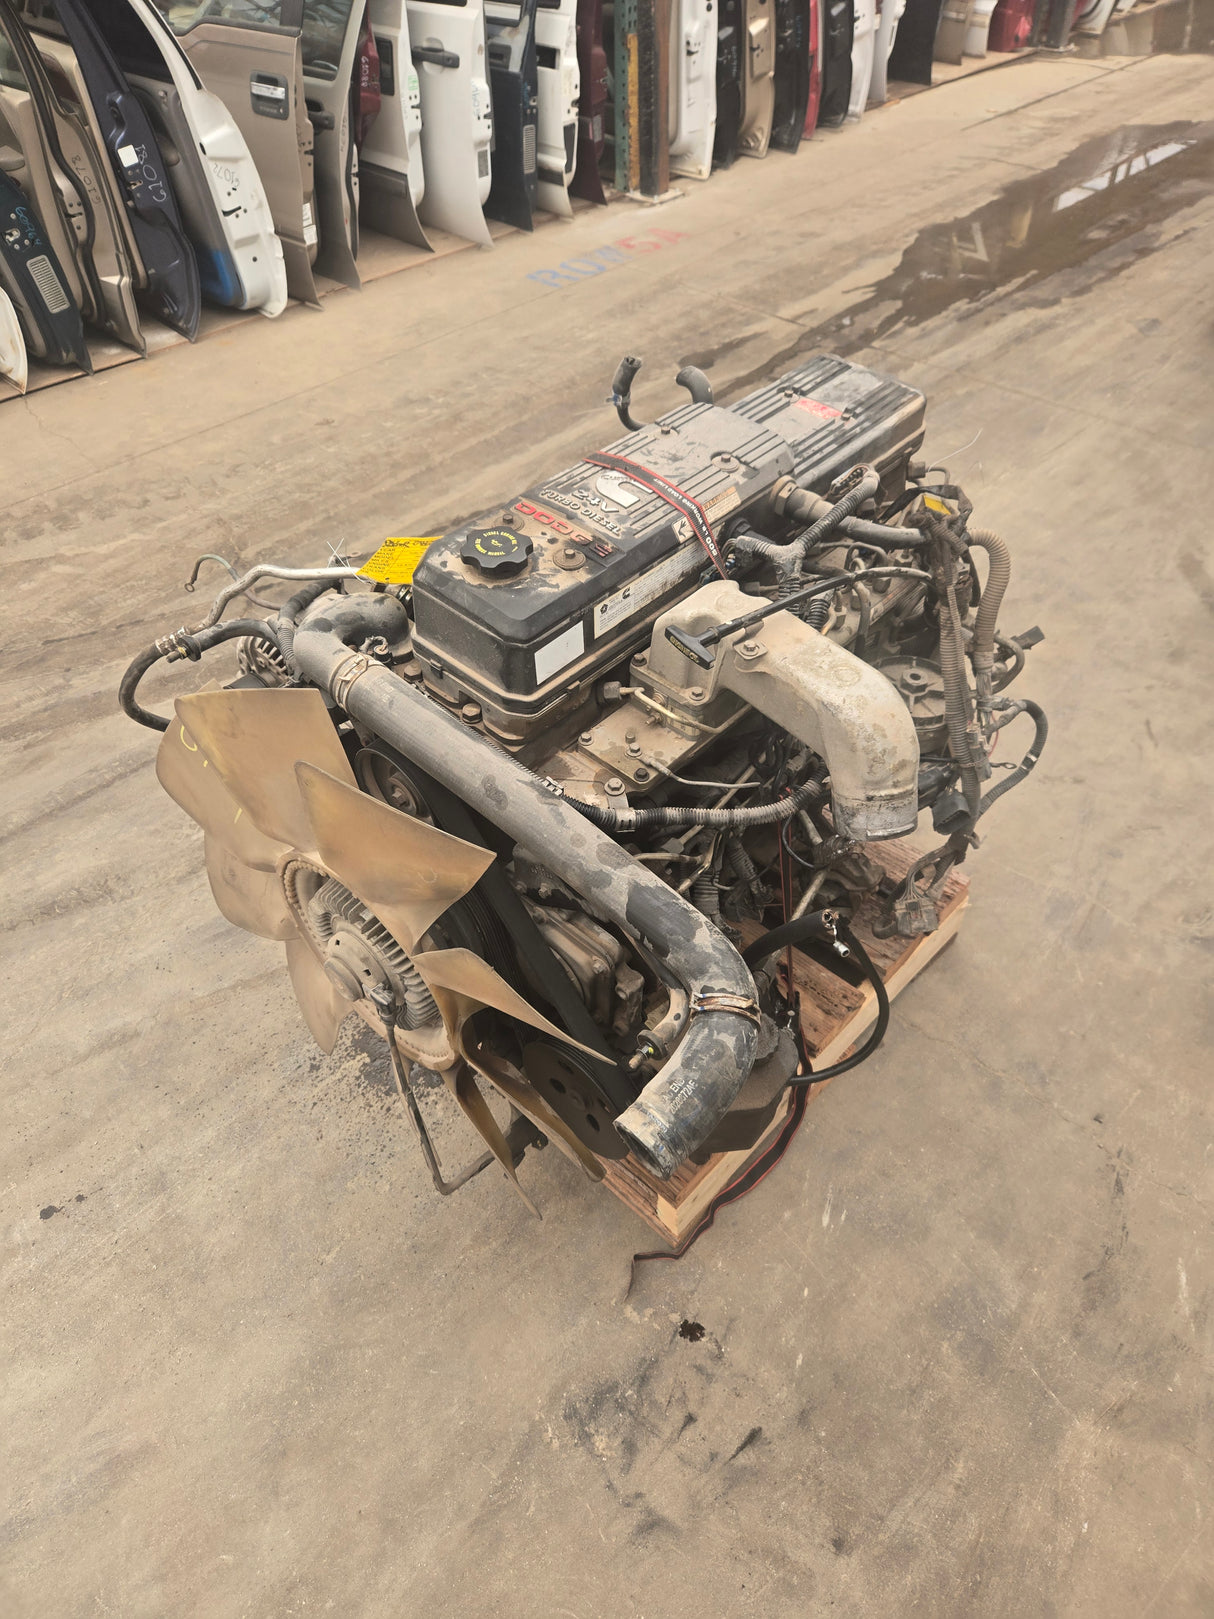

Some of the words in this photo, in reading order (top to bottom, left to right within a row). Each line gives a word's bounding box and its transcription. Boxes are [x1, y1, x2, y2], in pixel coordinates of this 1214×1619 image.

[526, 245, 633, 289] ROW
[571, 488, 620, 514] 24V
[666, 487, 684, 501] LOAD
[539, 488, 582, 511] TURBO
[580, 507, 623, 537] DIESEL
[681, 498, 704, 525] WORKING
[514, 501, 613, 559] DODGE
[705, 536, 719, 557] 500
[669, 1078, 686, 1094] END
